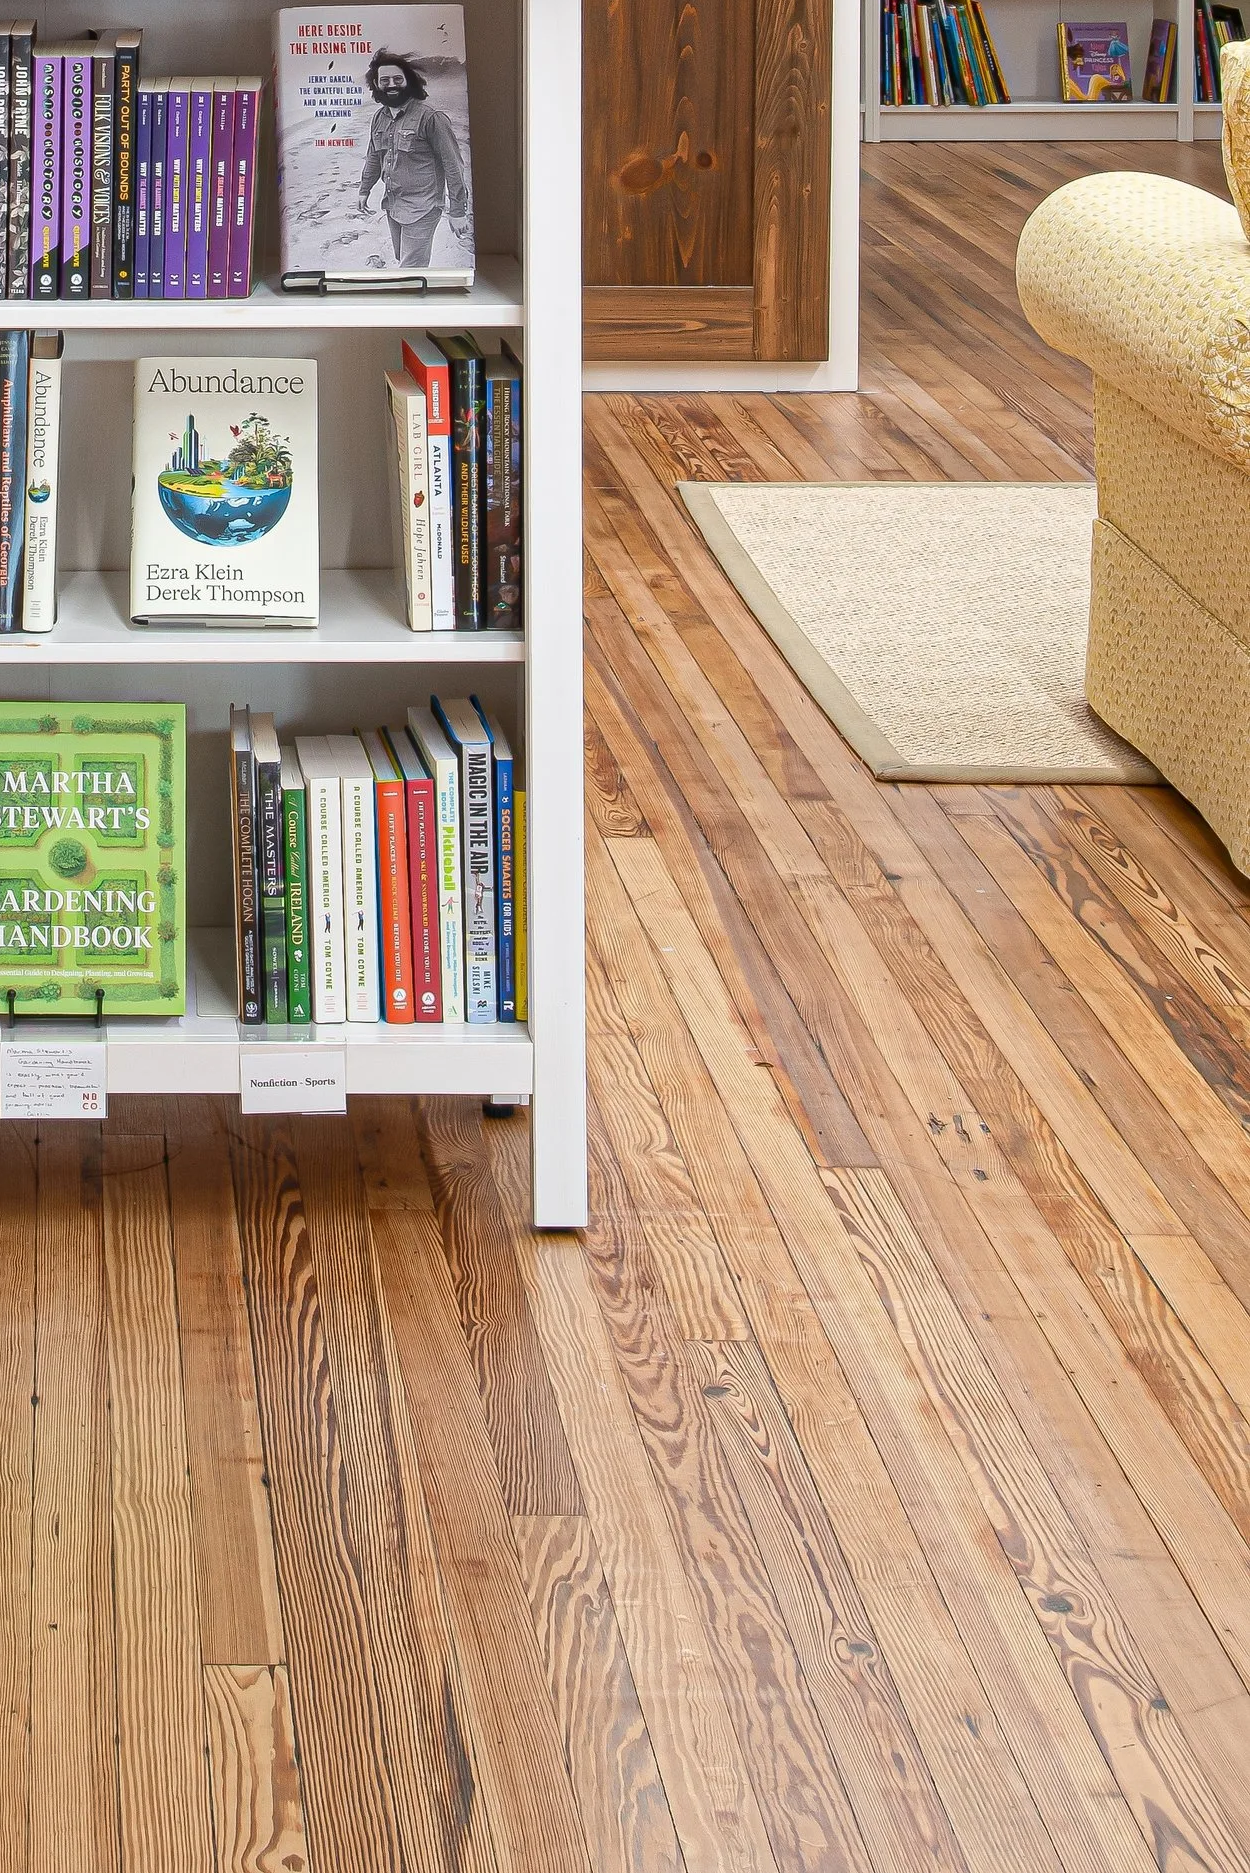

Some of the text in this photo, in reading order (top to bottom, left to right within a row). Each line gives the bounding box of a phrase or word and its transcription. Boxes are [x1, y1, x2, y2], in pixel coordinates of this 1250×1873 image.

[299, 25, 362, 37] HERE BESIDE
[290, 42, 372, 54] THE RISING TIDE
[147, 368, 305, 395] Abundance
[146, 564, 244, 581] Ezra Klein
[146, 585, 305, 606] Derek Thompson
[1, 770, 136, 795] MARTHA
[467, 753, 489, 875] MAGIC IN THE AIR
[264, 790, 277, 896] THE MASTERS
[442, 826, 456, 891] Pickleball
[290, 882, 303, 945] IRELAND
[250, 1078, 298, 1088] Nonfiction
[305, 1077, 336, 1089] Sports
